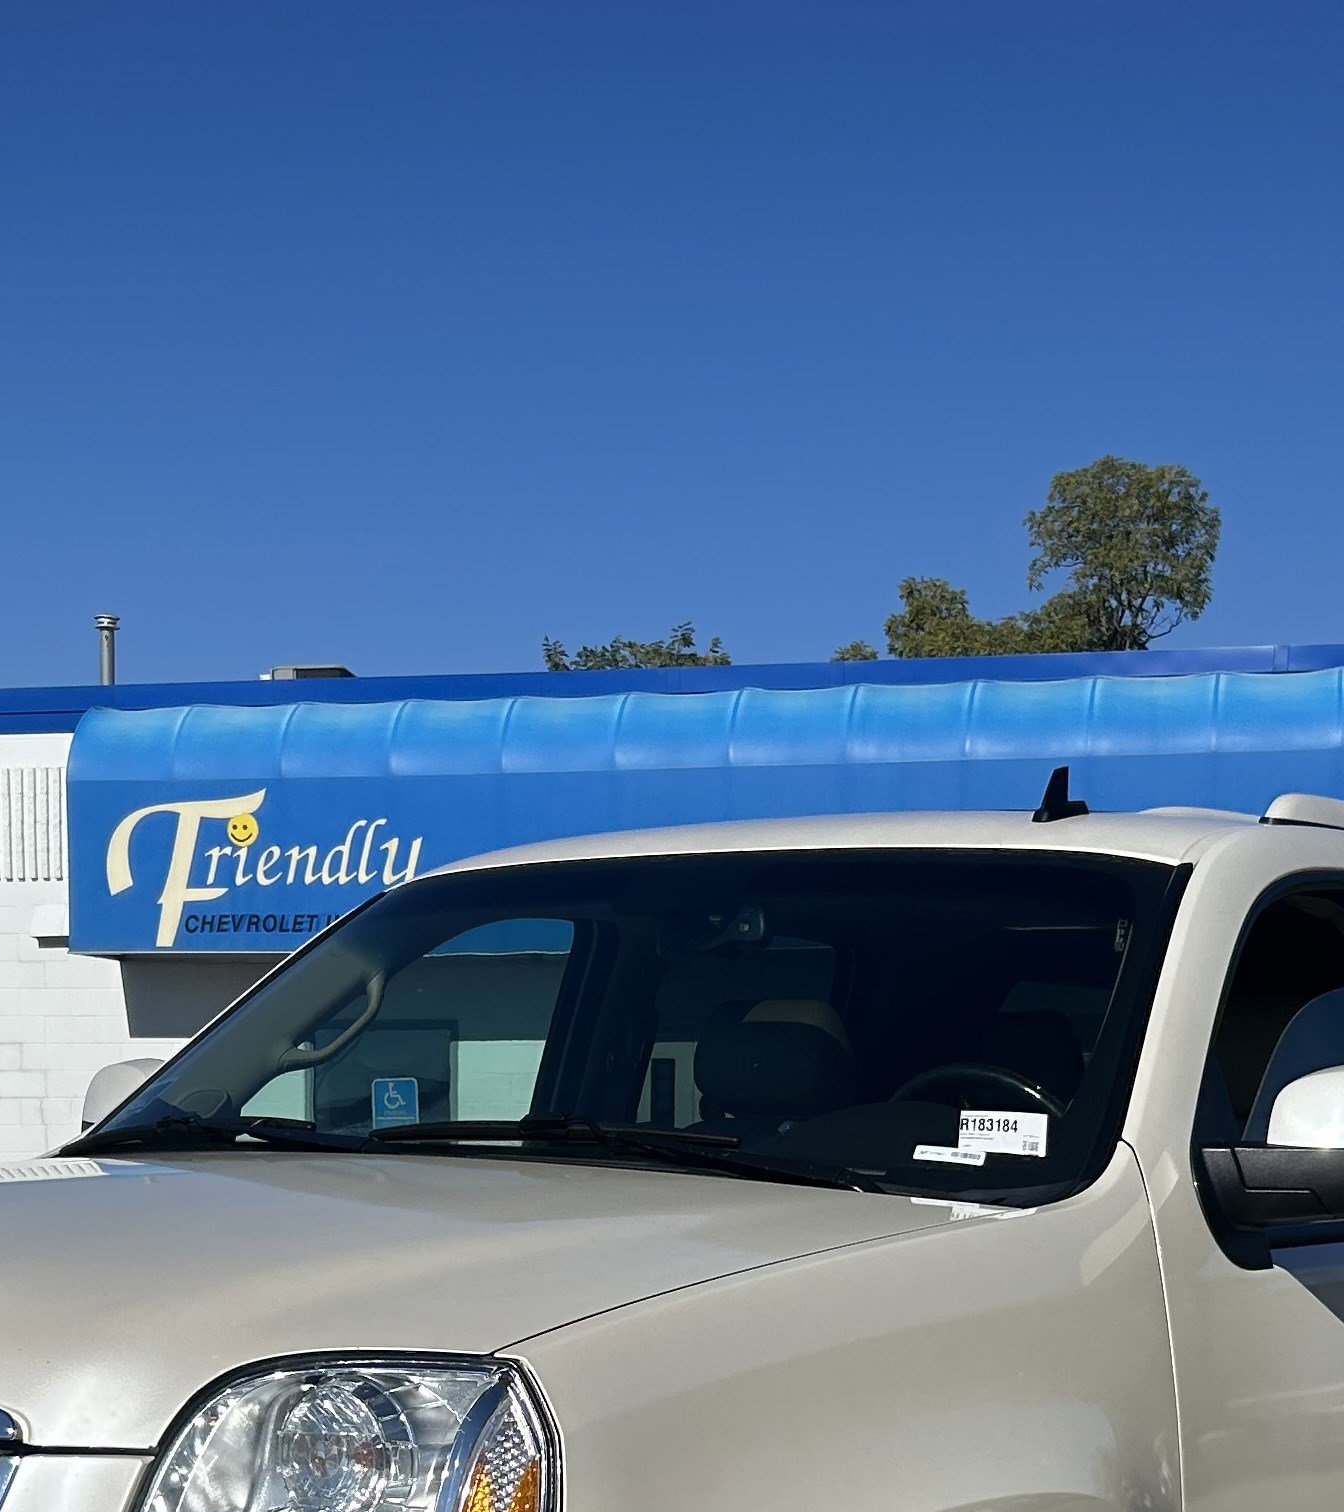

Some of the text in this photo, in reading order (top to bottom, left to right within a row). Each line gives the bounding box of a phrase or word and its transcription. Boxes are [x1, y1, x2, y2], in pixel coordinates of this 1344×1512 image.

[106, 788, 423, 947] Friendly
[184, 914, 318, 934] CHEVROLET
[959, 1117, 1018, 1133] R183184
